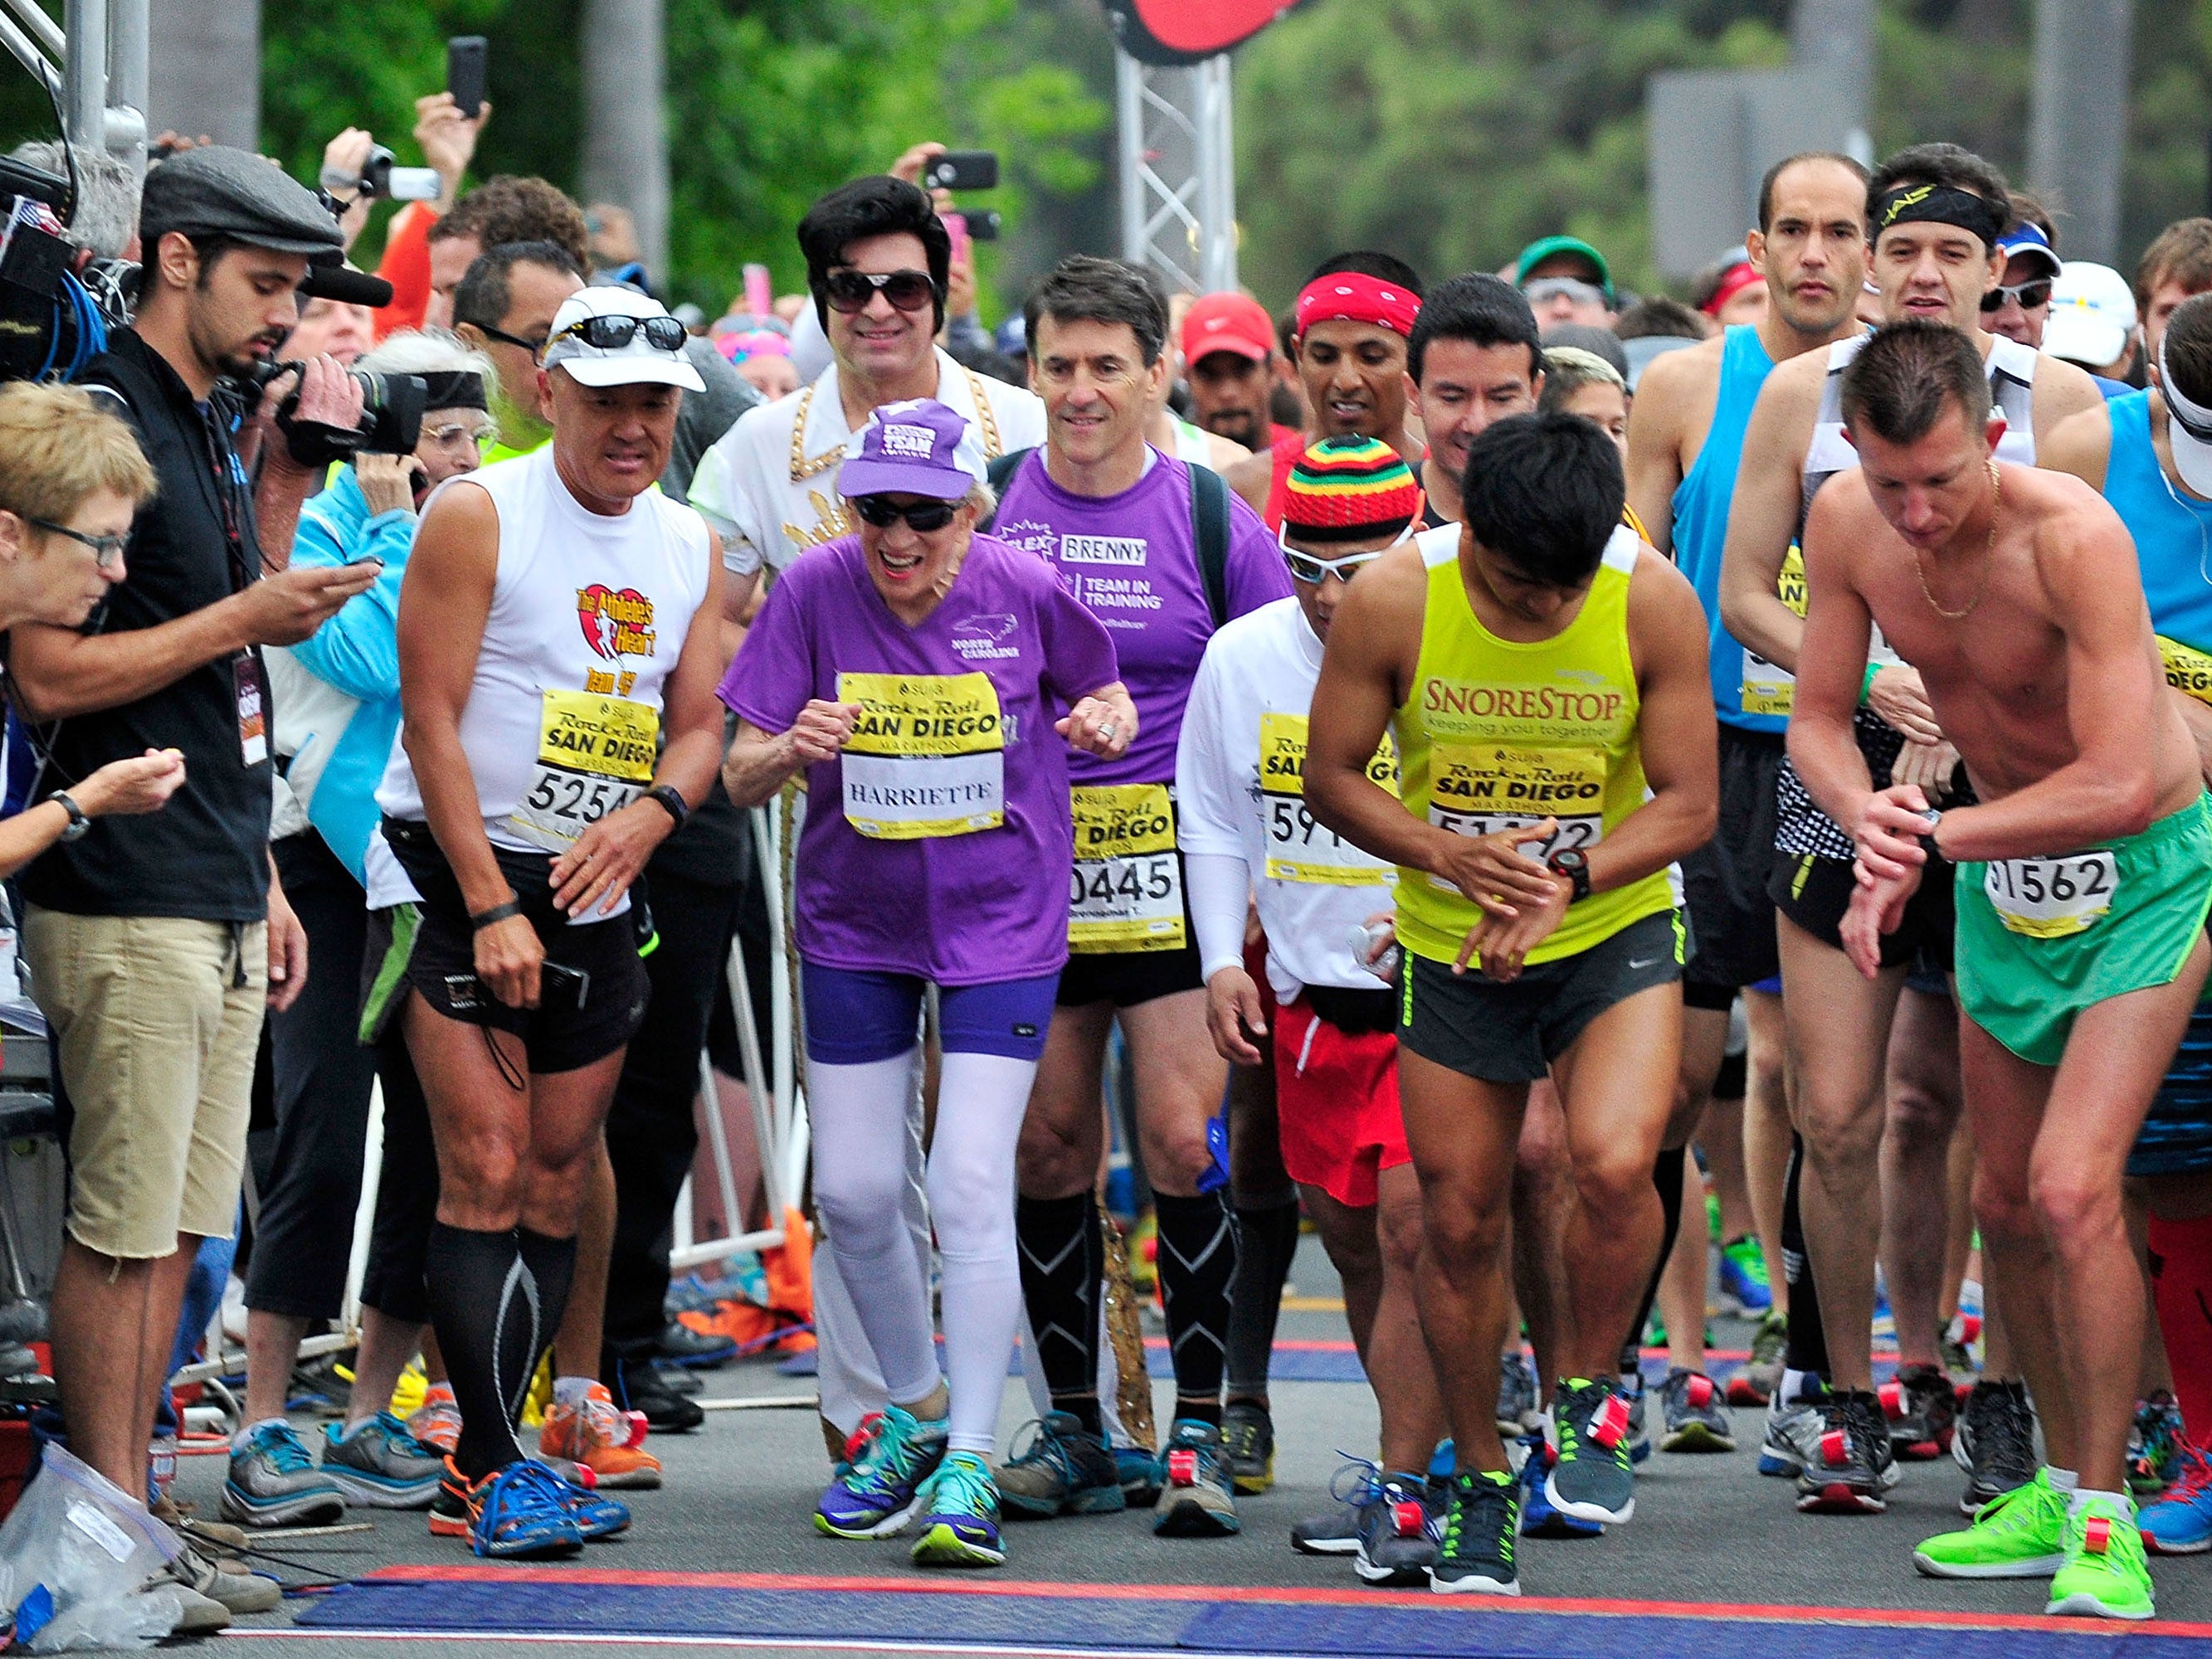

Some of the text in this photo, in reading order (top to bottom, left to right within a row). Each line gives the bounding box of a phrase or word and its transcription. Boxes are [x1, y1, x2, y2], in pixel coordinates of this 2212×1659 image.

[1066, 538, 1146, 562] BRENNY
[1085, 578, 1151, 595] TEAM IN
[576, 588, 654, 625] The Athlete's
[1084, 592, 1162, 610] TRAINING
[615, 623, 656, 657] Heart
[913, 714, 996, 737] DIEGO
[546, 728, 654, 765] SAN DIEGO
[850, 782, 993, 808] HARRIETTE
[1435, 777, 1601, 801] SAN DIEGO
[1089, 815, 1169, 844] DIEGO
